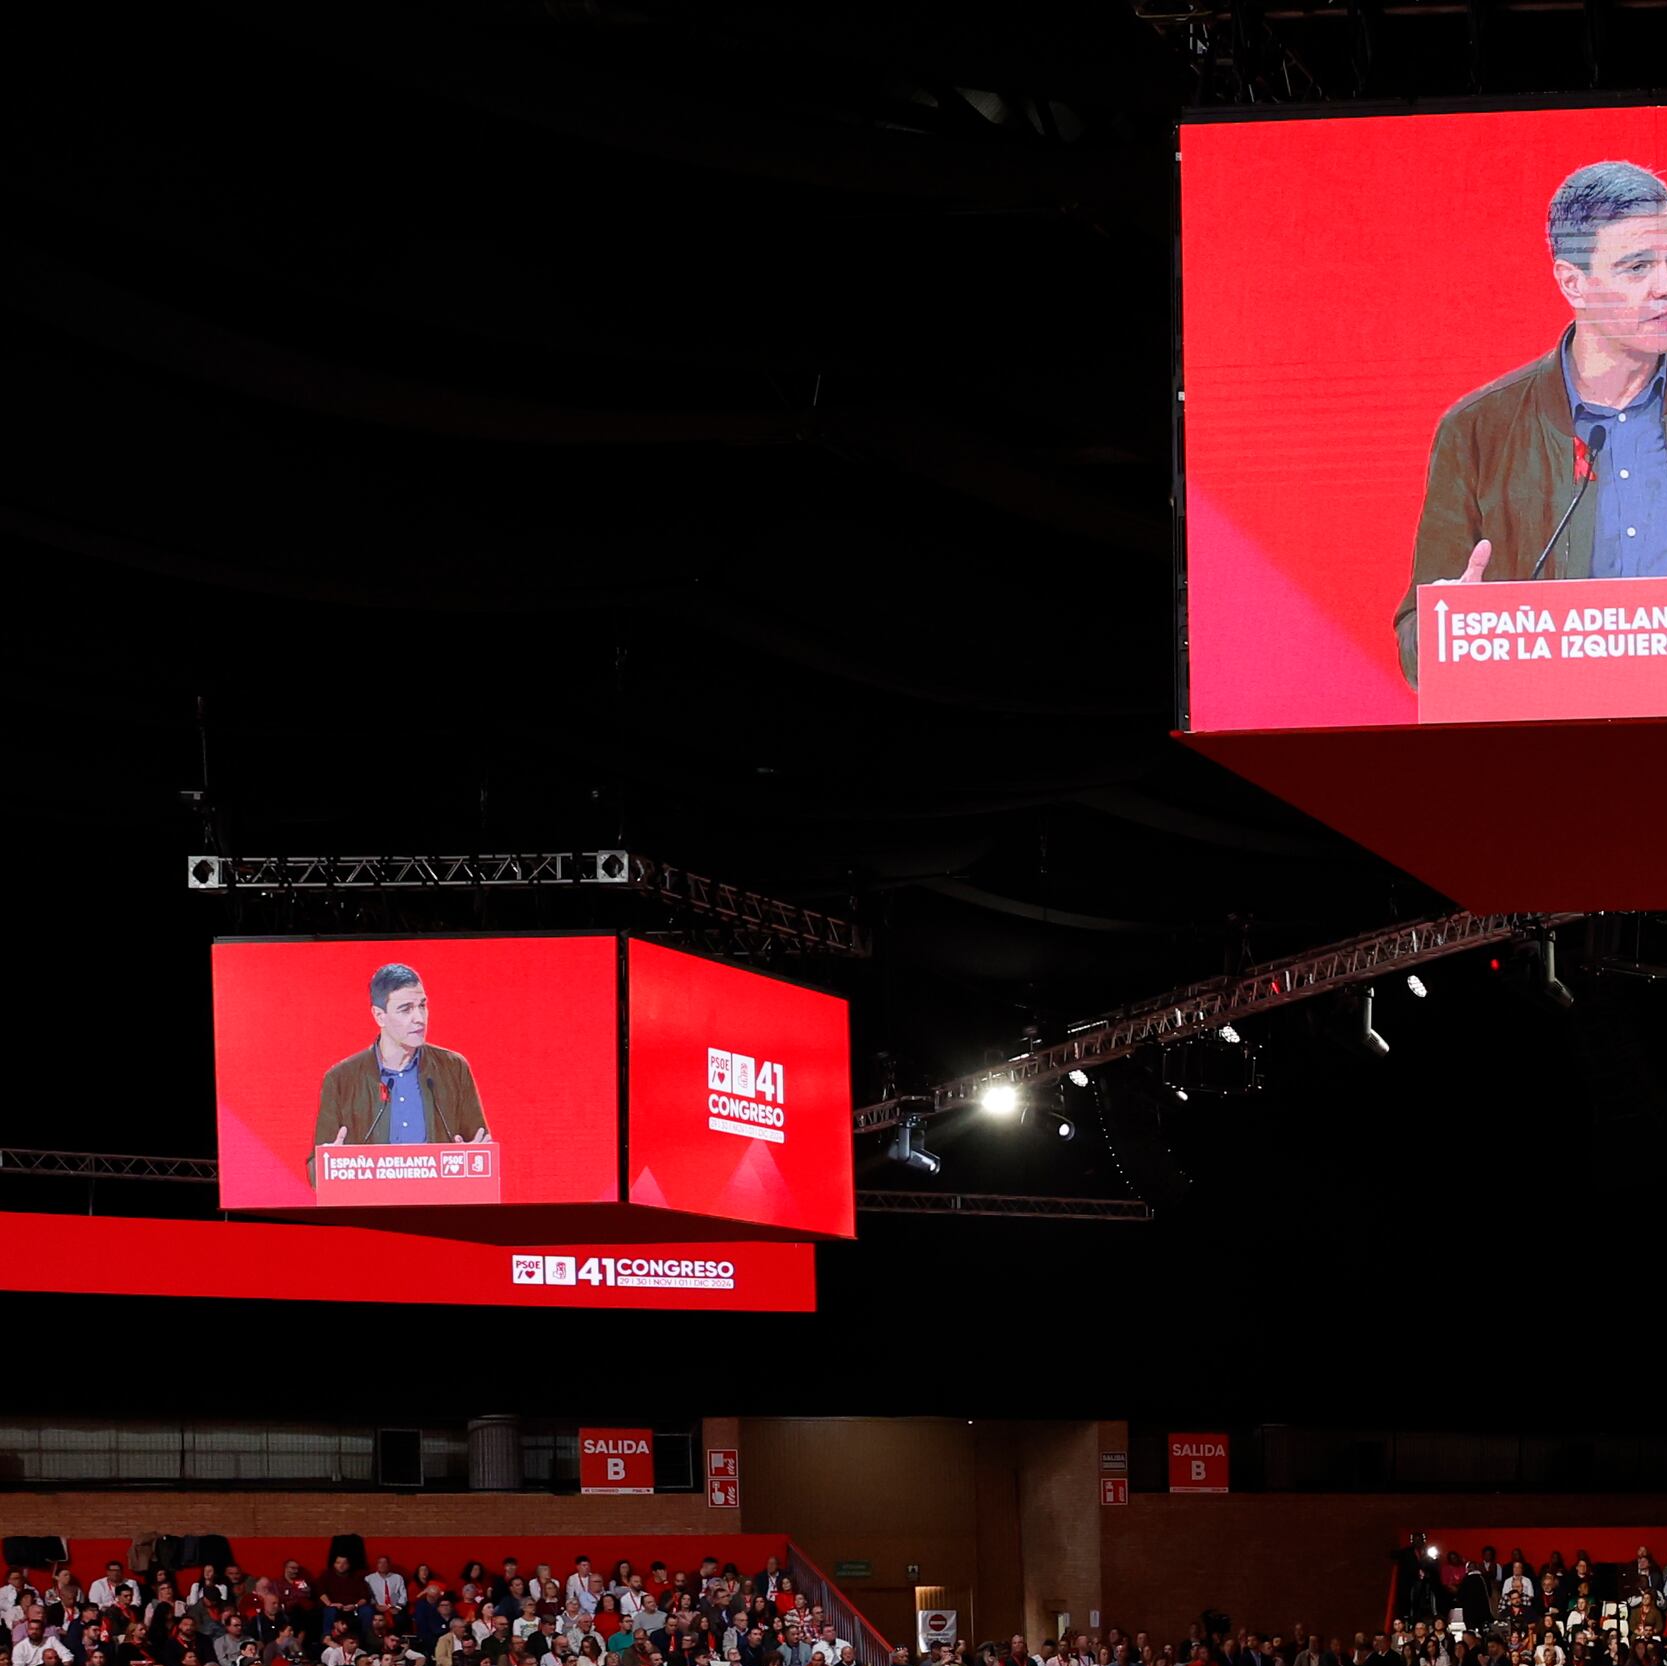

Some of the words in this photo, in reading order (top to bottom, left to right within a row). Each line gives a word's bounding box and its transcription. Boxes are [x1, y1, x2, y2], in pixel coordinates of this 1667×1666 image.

[1451, 606, 1556, 636] ESPAÑA
[1452, 638, 1510, 662] POR
[1518, 636, 1552, 660] LA
[756, 1061, 784, 1104] 41
[708, 1093, 785, 1128] CONGRESO
[330, 1155, 375, 1169] ESPAÑA
[376, 1156, 437, 1168] ADELANTA
[330, 1168, 357, 1180] POR
[358, 1168, 373, 1180] LA
[376, 1168, 438, 1180] IZQUIERDA
[515, 1260, 541, 1270] PSOE
[578, 1257, 616, 1287] 41
[616, 1258, 735, 1278] CONGRESO
[584, 1439, 650, 1454] SALIDA
[1172, 1444, 1226, 1456] SALIDA
[607, 1458, 626, 1480] B
[1191, 1460, 1206, 1480] B
